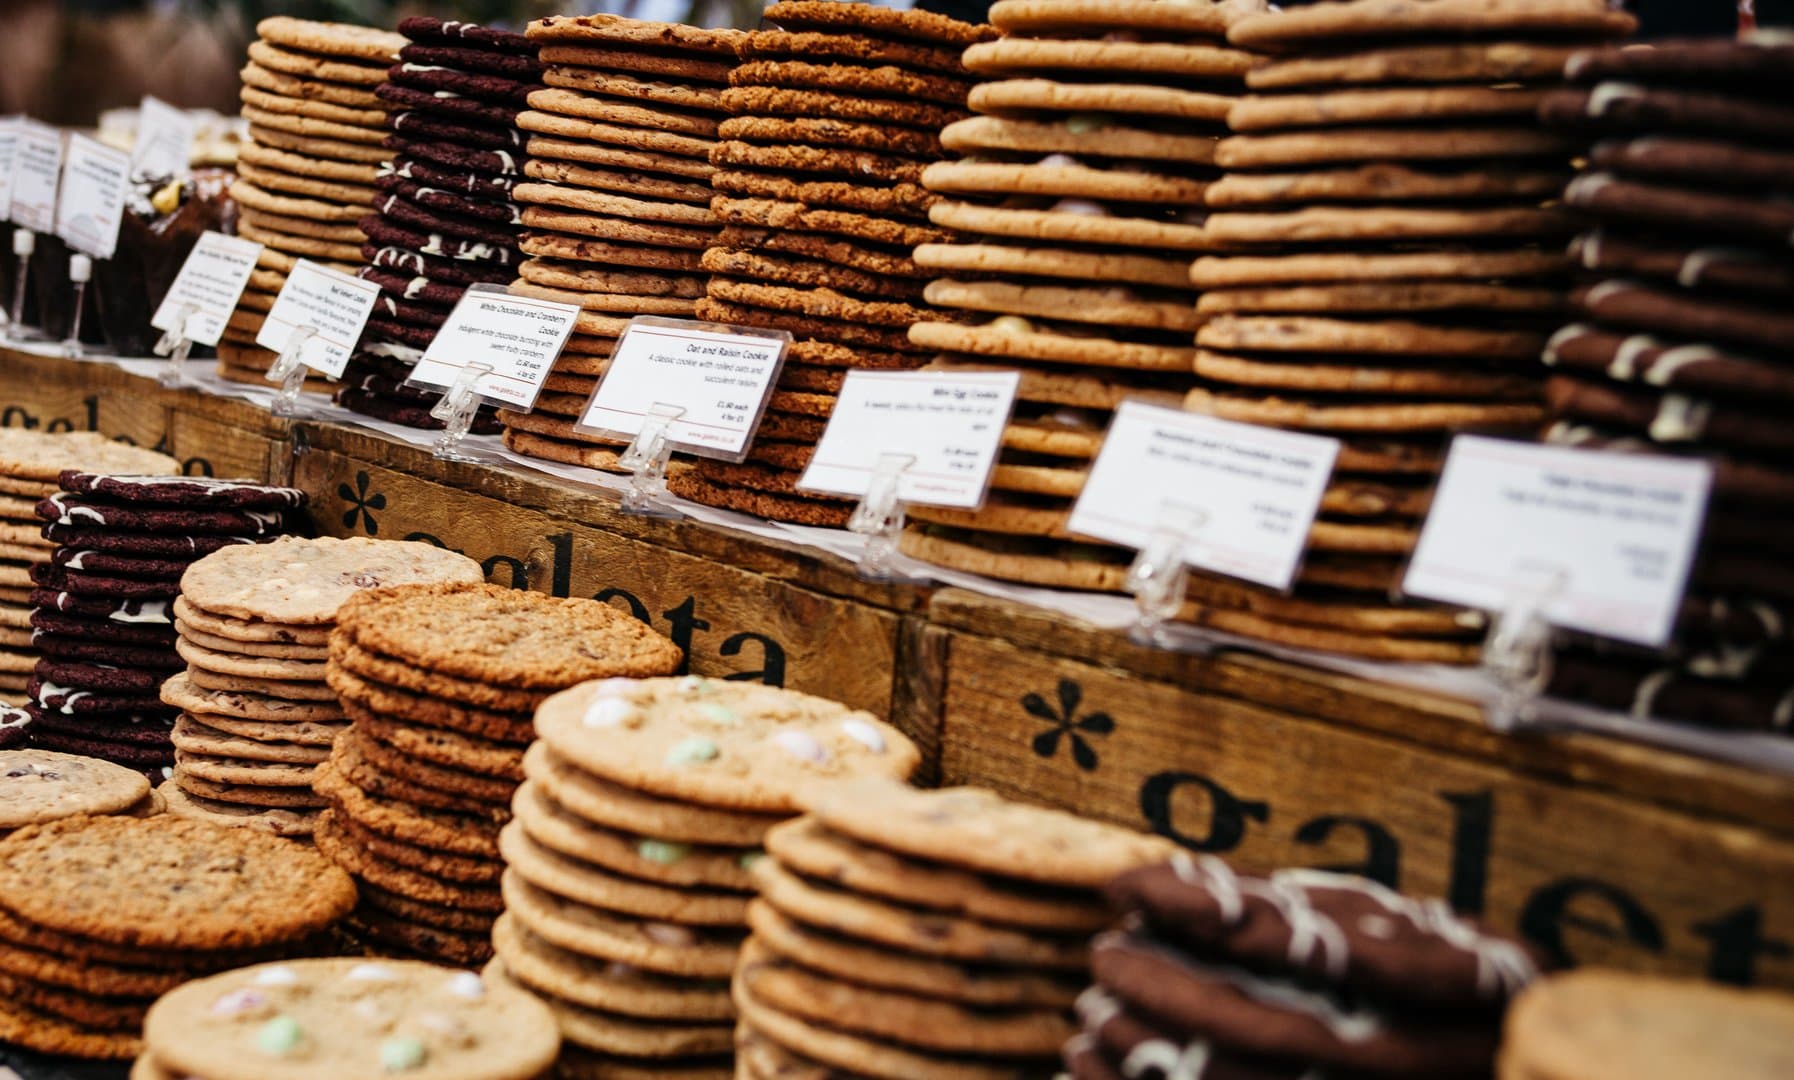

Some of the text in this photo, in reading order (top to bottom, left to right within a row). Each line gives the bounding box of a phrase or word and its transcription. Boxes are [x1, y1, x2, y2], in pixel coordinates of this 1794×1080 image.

[480, 302, 566, 326] White Chocolate and Cranberry
[538, 325, 560, 337] Cookie
[480, 328, 495, 337] white
[495, 330, 519, 342] chocolate
[519, 335, 540, 347] bursting
[540, 338, 553, 348] with
[686, 343, 769, 361] Oat and Raisin Cookie
[529, 360, 541, 370] each
[654, 354, 675, 364] classic
[675, 356, 698, 367] cookie
[699, 359, 713, 369] with
[714, 361, 734, 372] rolled
[734, 364, 750, 373] oats
[750, 365, 765, 375] and
[704, 375, 737, 386] succulent
[734, 403, 749, 412] each
[727, 414, 737, 423] for
